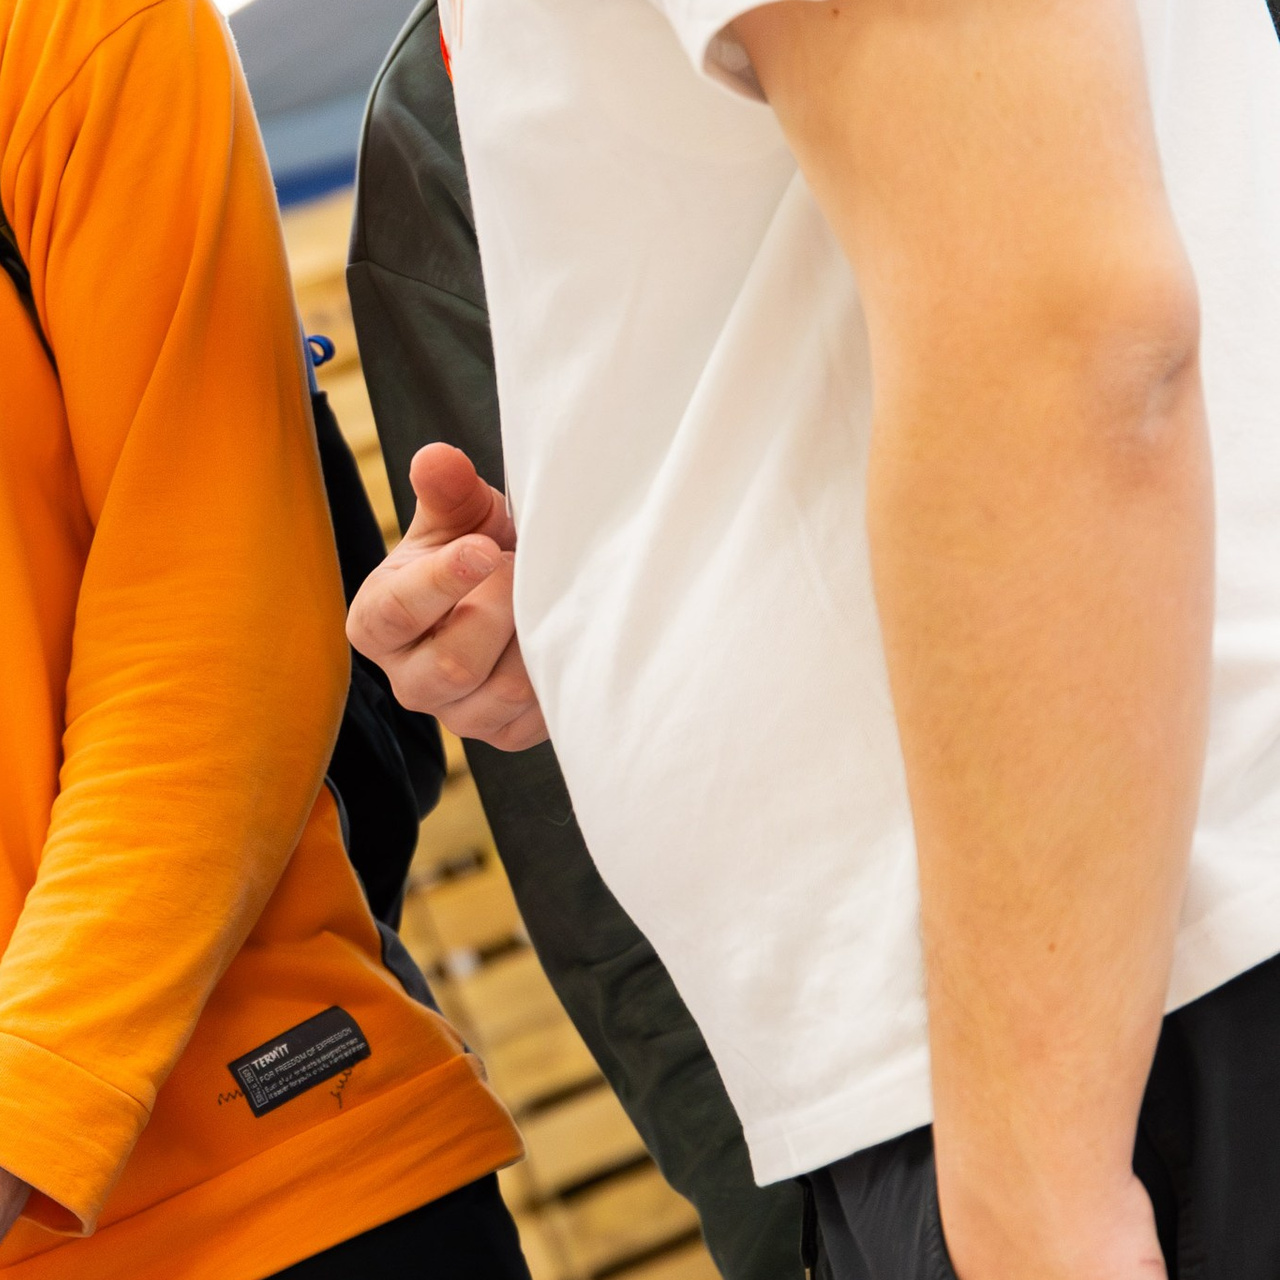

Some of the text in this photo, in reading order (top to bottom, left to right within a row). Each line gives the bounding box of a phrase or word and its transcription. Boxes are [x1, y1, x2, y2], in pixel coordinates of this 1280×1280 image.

[260, 1070, 276, 1083] FOR
[275, 1053, 308, 1075] FREEDOM
[306, 1047, 316, 1057] OF
[316, 1027, 353, 1052] EXPRESSION
